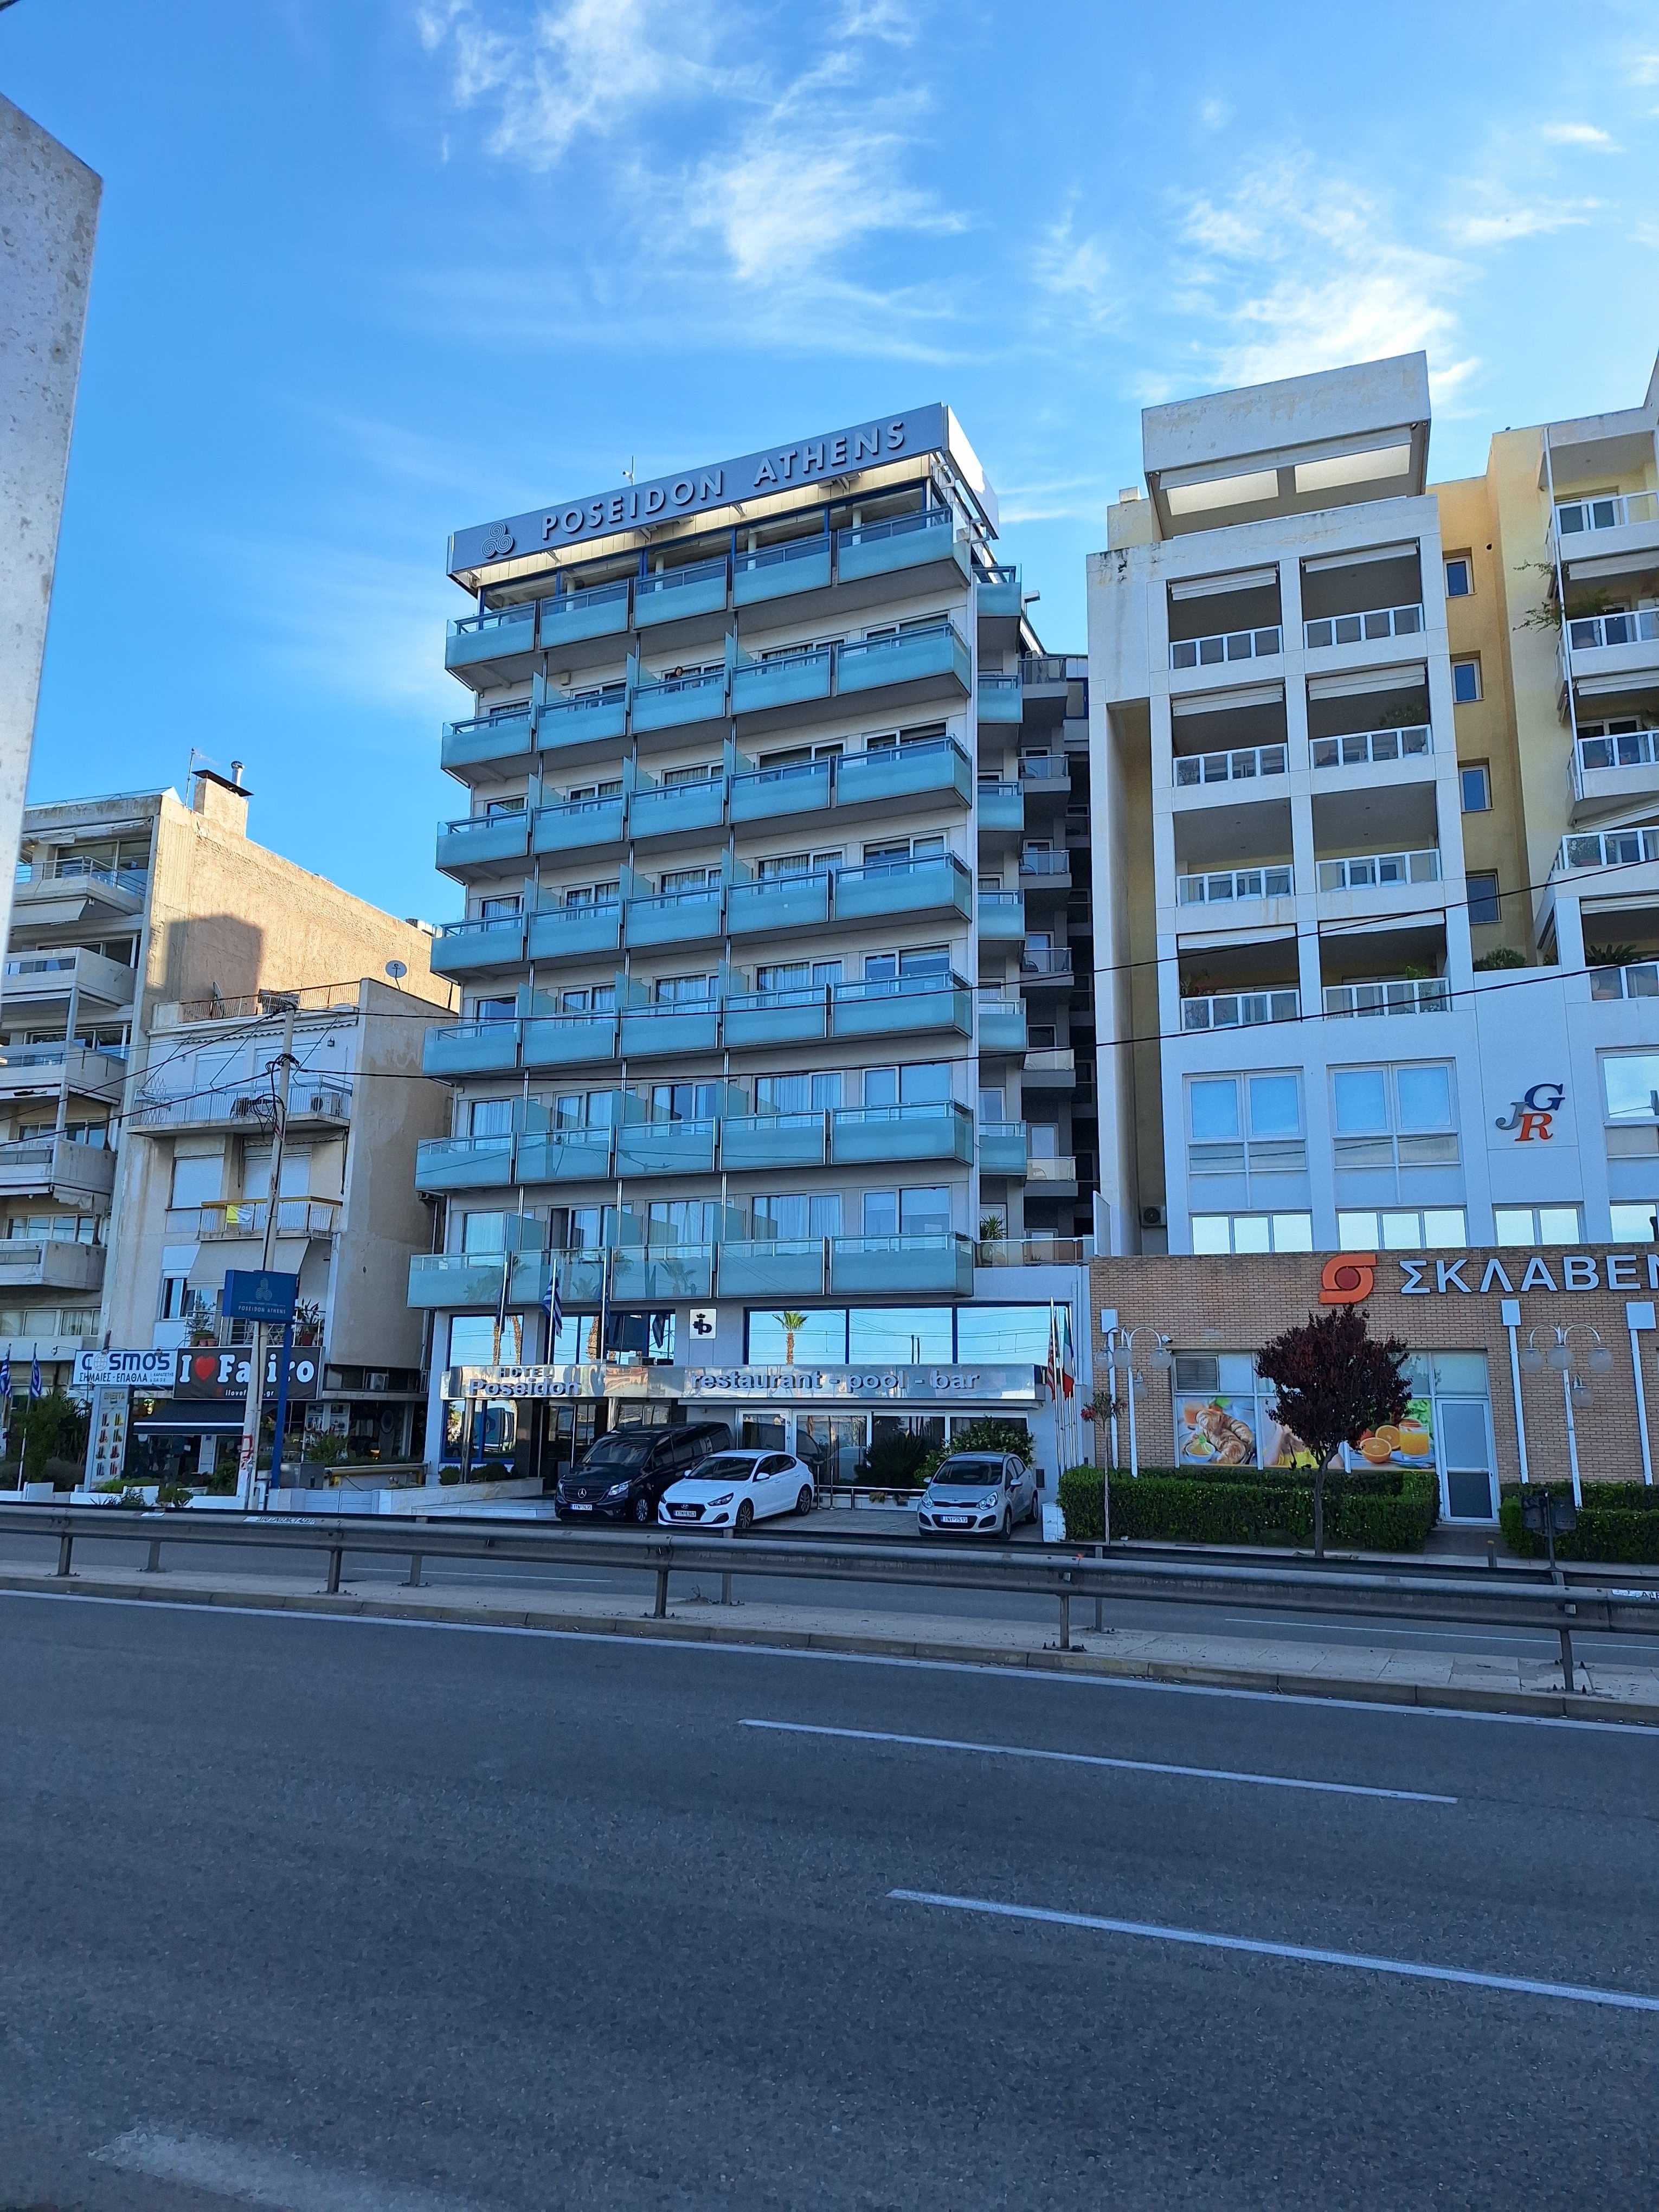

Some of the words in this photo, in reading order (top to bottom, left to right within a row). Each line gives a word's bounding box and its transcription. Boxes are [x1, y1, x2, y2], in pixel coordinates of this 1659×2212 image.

[542, 469, 723, 541] POSEIDON
[753, 421, 904, 487] ATHENS
[79, 1372, 111, 1382] ΣΗΜΑΙΕΣ
[116, 1373, 147, 1382] ΕΠΑΘΛΑ
[179, 1354, 192, 1382] I
[217, 1353, 314, 1383] Faio
[499, 1367, 554, 1378] HOTEL
[469, 1378, 582, 1396] Poseidon
[691, 1371, 822, 1388] restaurant
[845, 1370, 906, 1393] pool
[931, 1370, 980, 1389] bar
